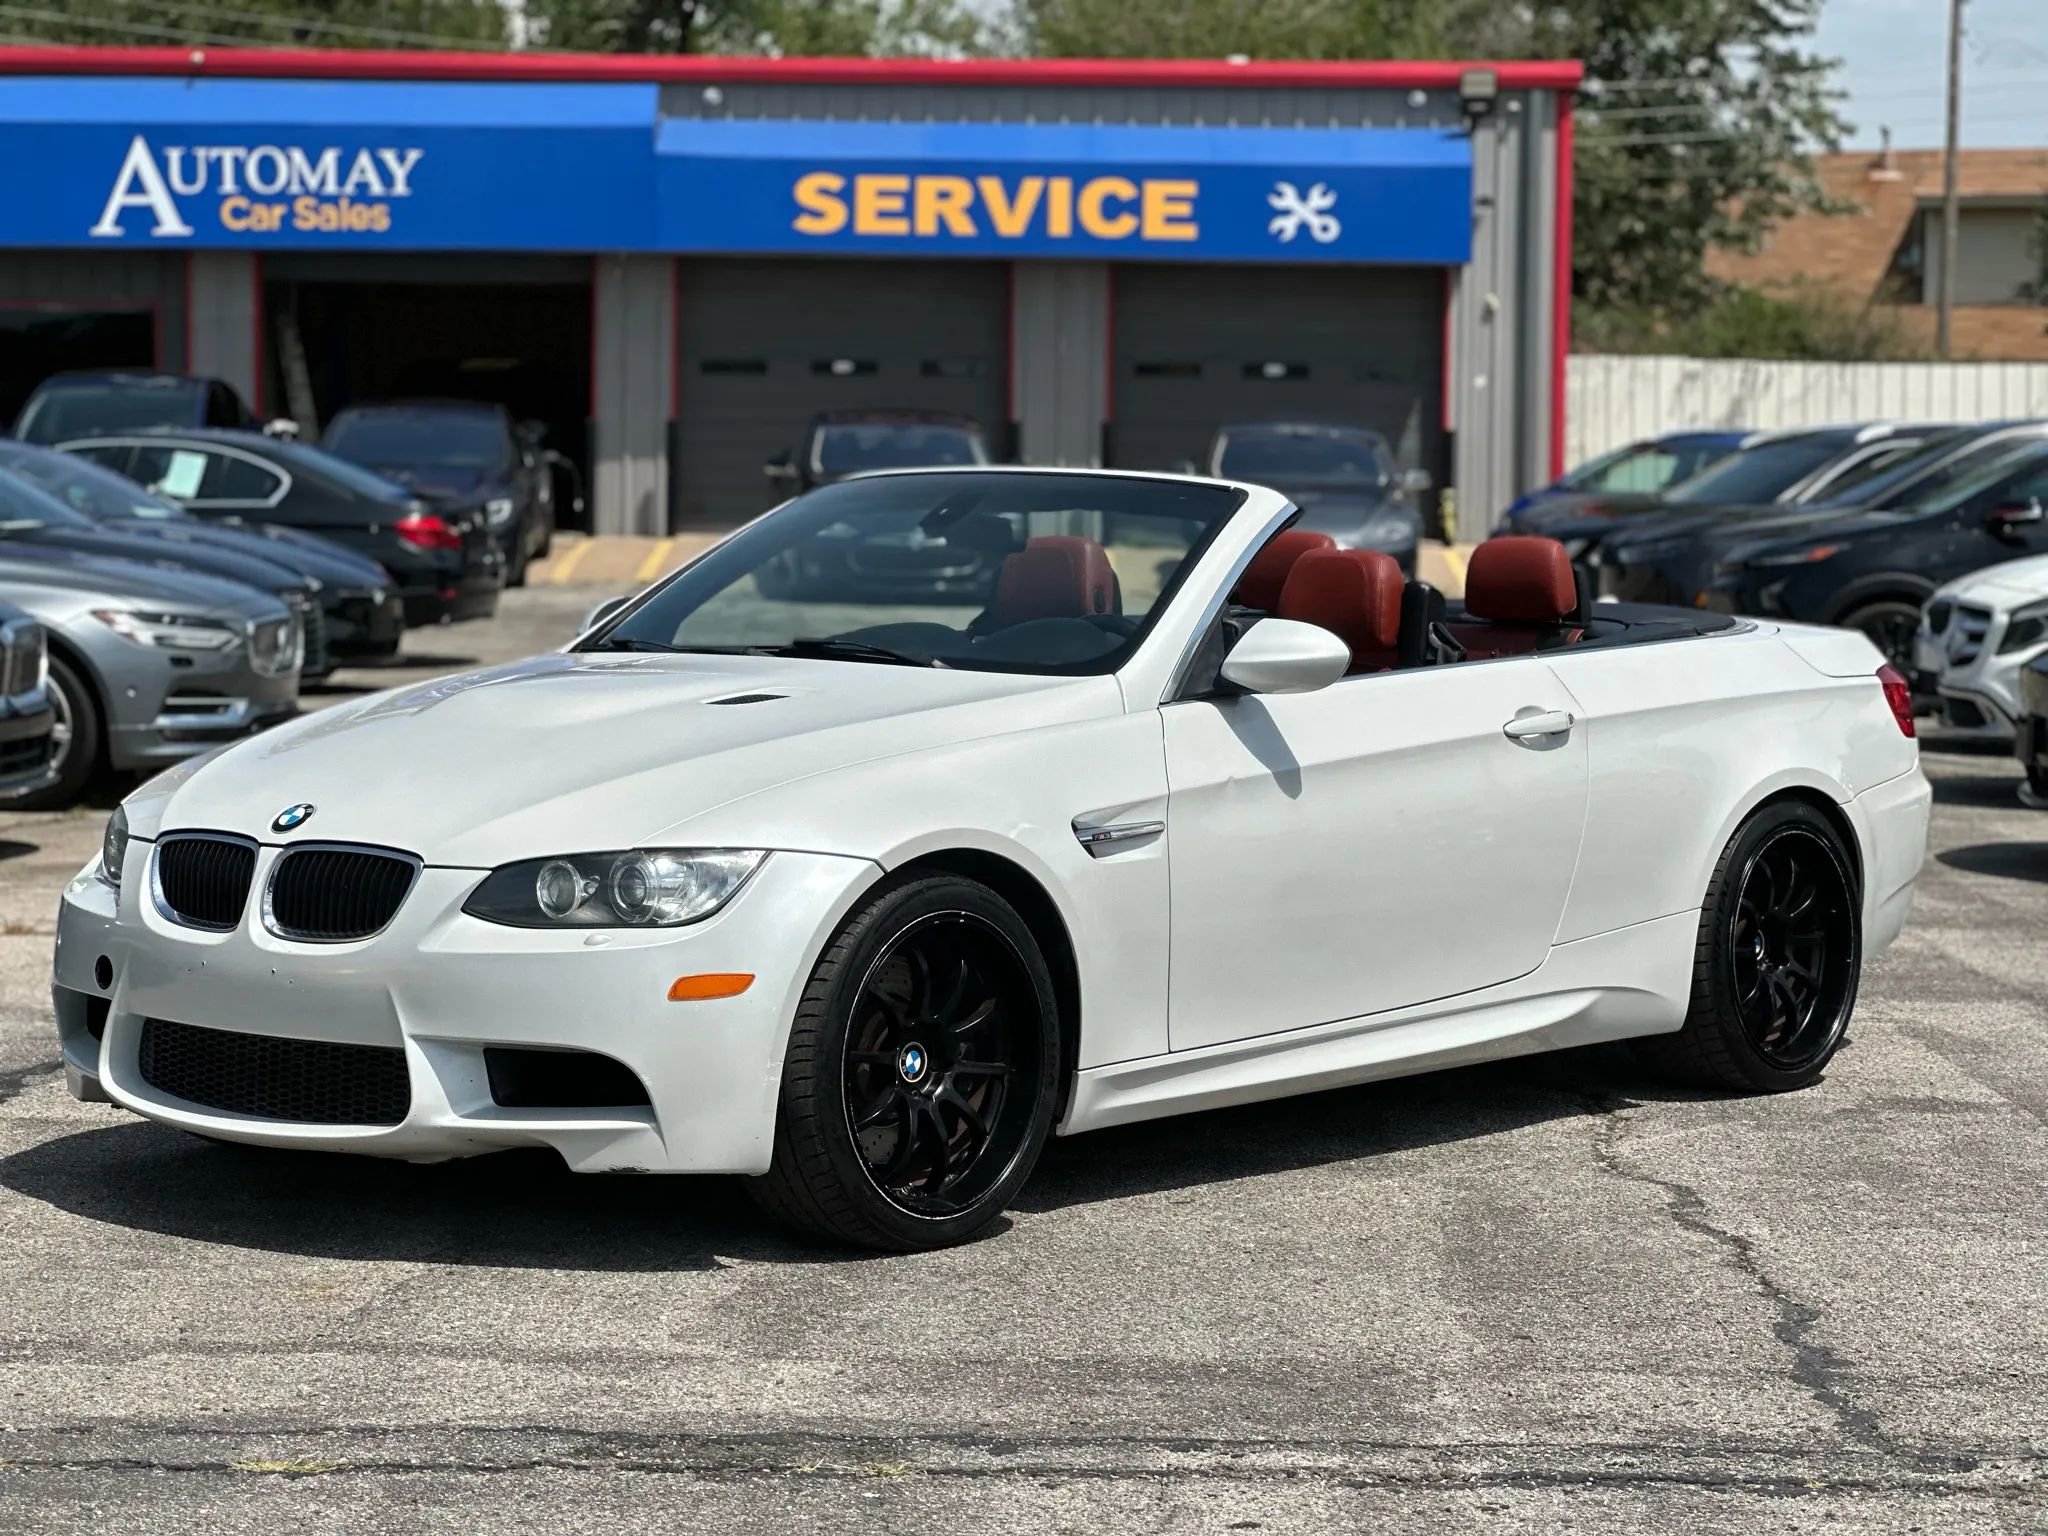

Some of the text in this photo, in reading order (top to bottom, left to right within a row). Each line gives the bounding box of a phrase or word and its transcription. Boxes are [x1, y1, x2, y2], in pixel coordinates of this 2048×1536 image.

[89, 134, 424, 237] AUTOMAY
[220, 195, 391, 232] Car Sales
[793, 172, 1199, 241] SERVICE
